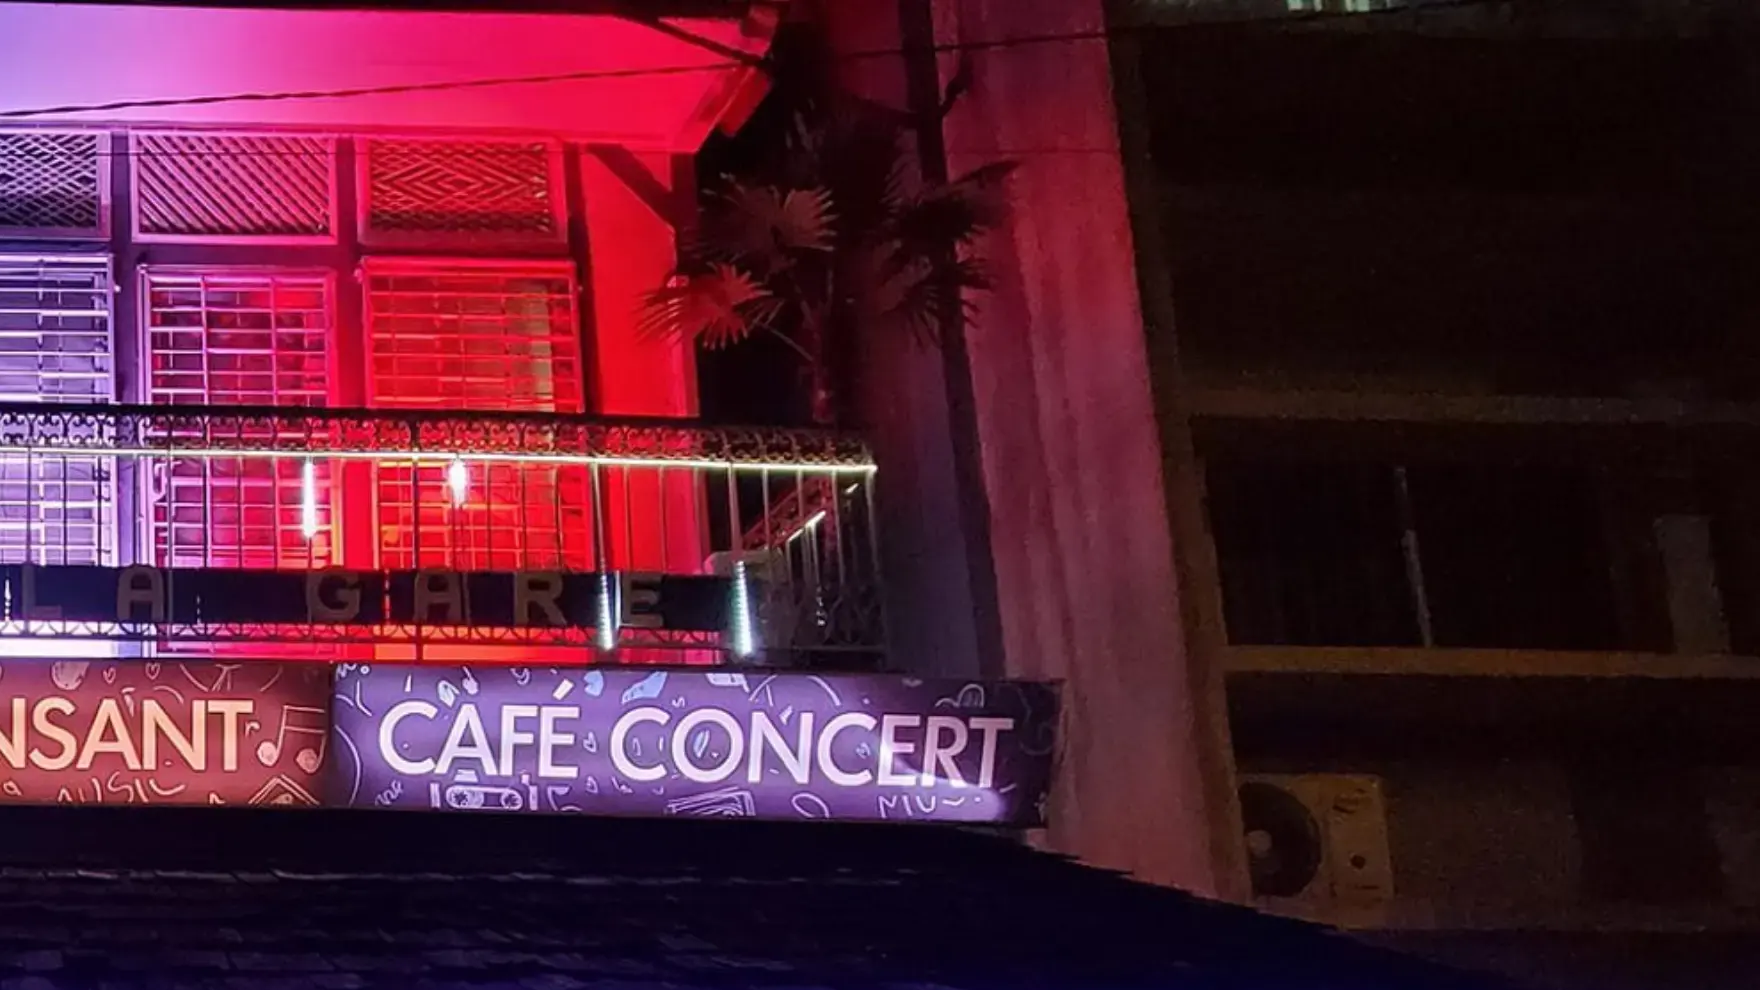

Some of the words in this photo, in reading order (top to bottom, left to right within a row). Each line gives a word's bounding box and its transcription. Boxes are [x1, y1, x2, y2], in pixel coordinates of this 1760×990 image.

[23, 565, 165, 621] LA
[305, 569, 664, 628] GARE
[379, 679, 579, 778] CAFÉ
[611, 708, 1013, 788] CONCERT
